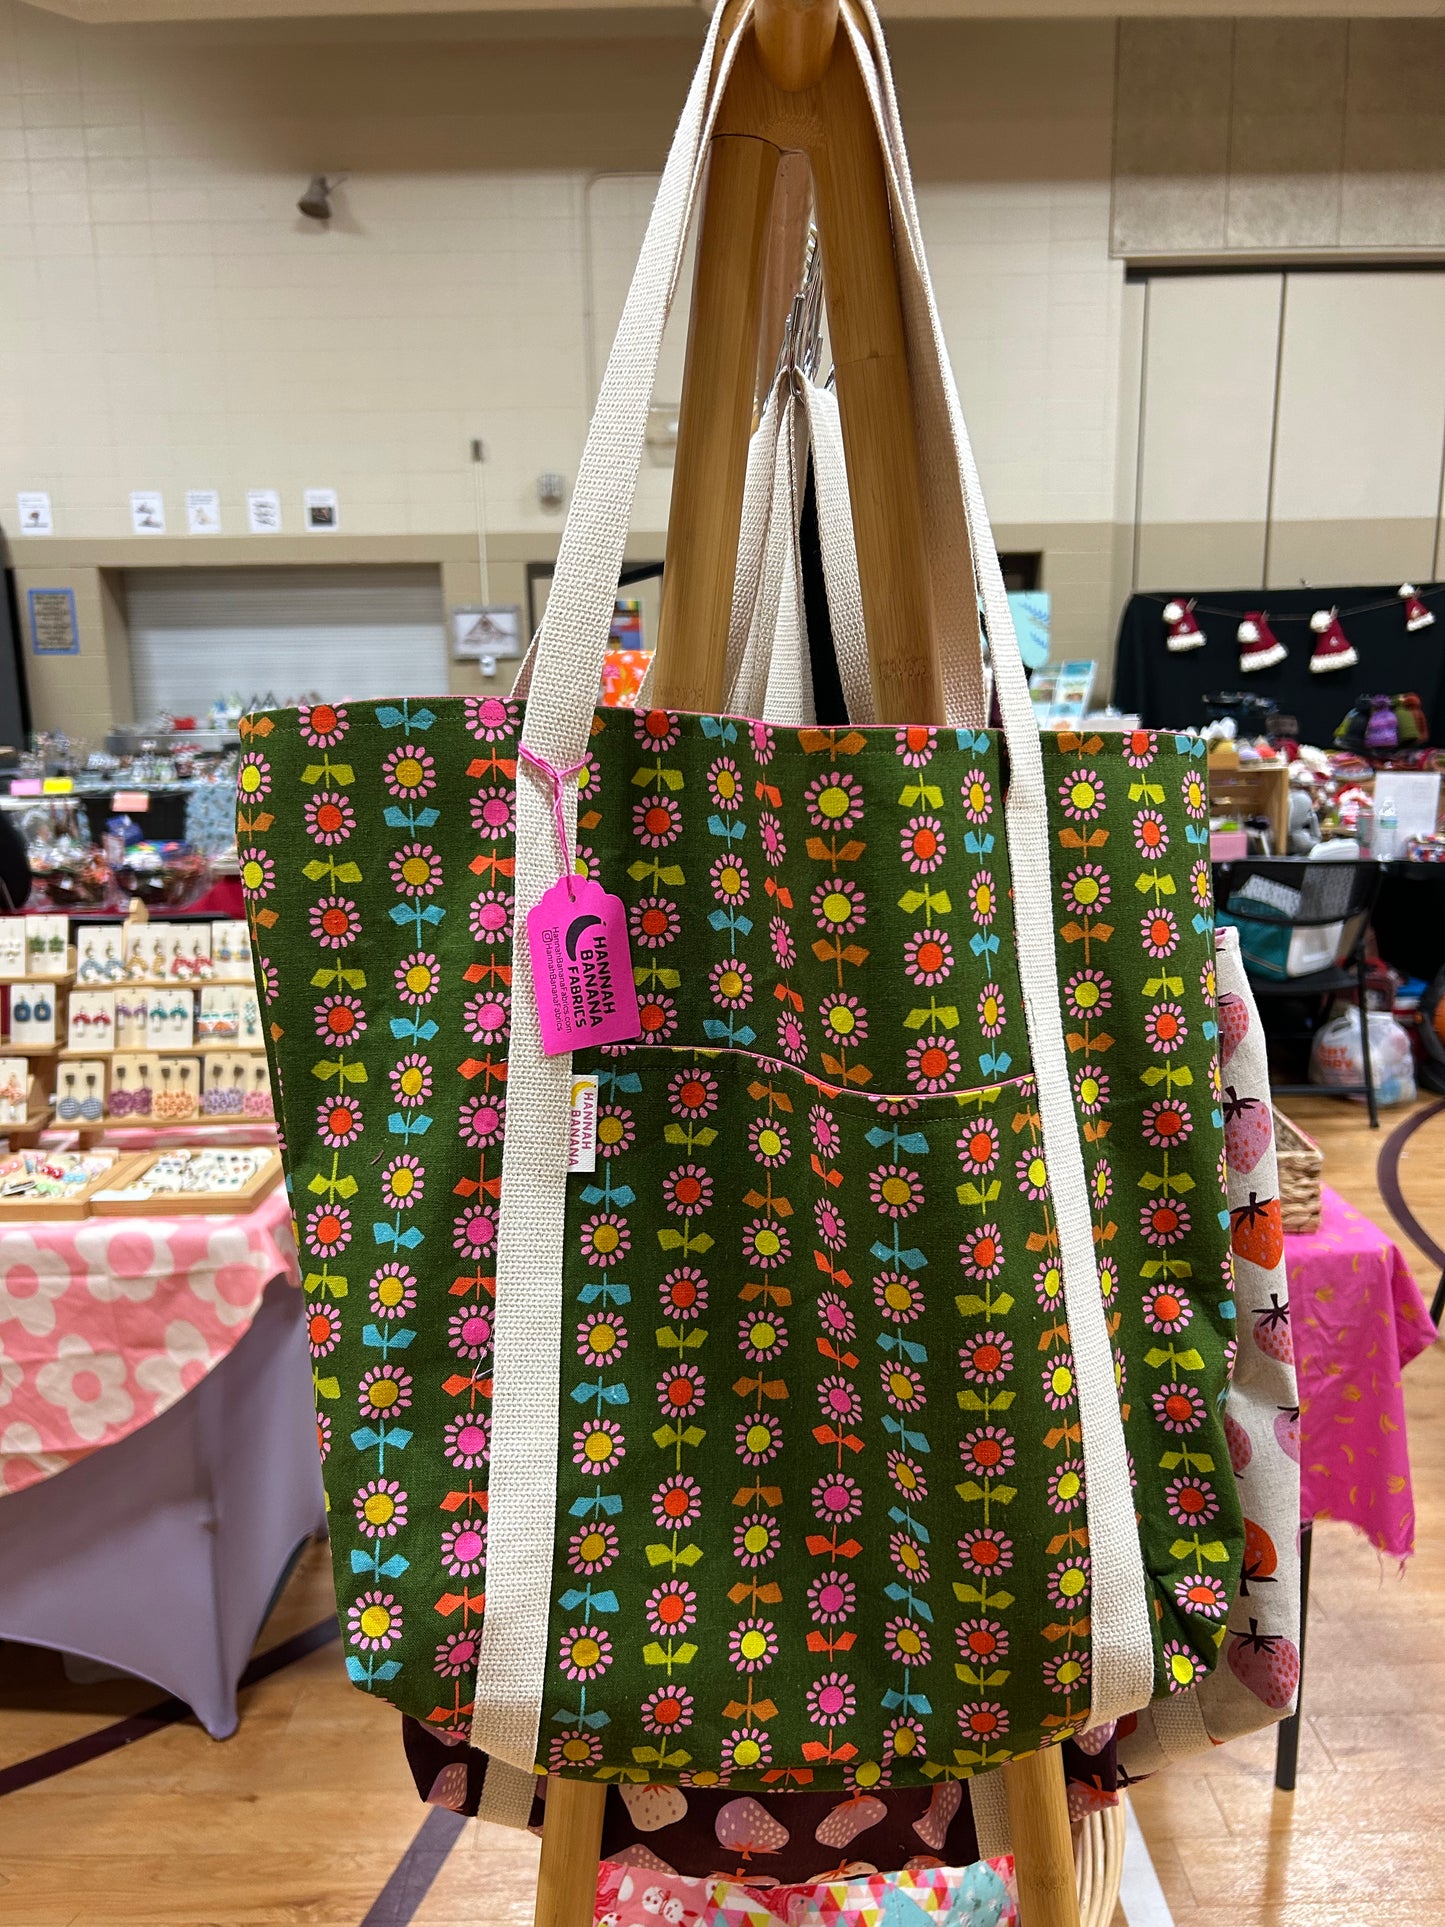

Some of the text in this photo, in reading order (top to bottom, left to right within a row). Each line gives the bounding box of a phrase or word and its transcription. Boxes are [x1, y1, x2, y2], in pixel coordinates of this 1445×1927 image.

[545, 943, 563, 1032] HannahBananaFabrics
[552, 926, 572, 1034] HannahBananaFabrics.com
[568, 966, 587, 1028] FABRICS
[581, 950, 603, 1027] BANANA
[593, 936, 616, 1014] HANNAH
[569, 1110, 581, 1166] BANANA
[582, 1092, 594, 1150] HANNAH
